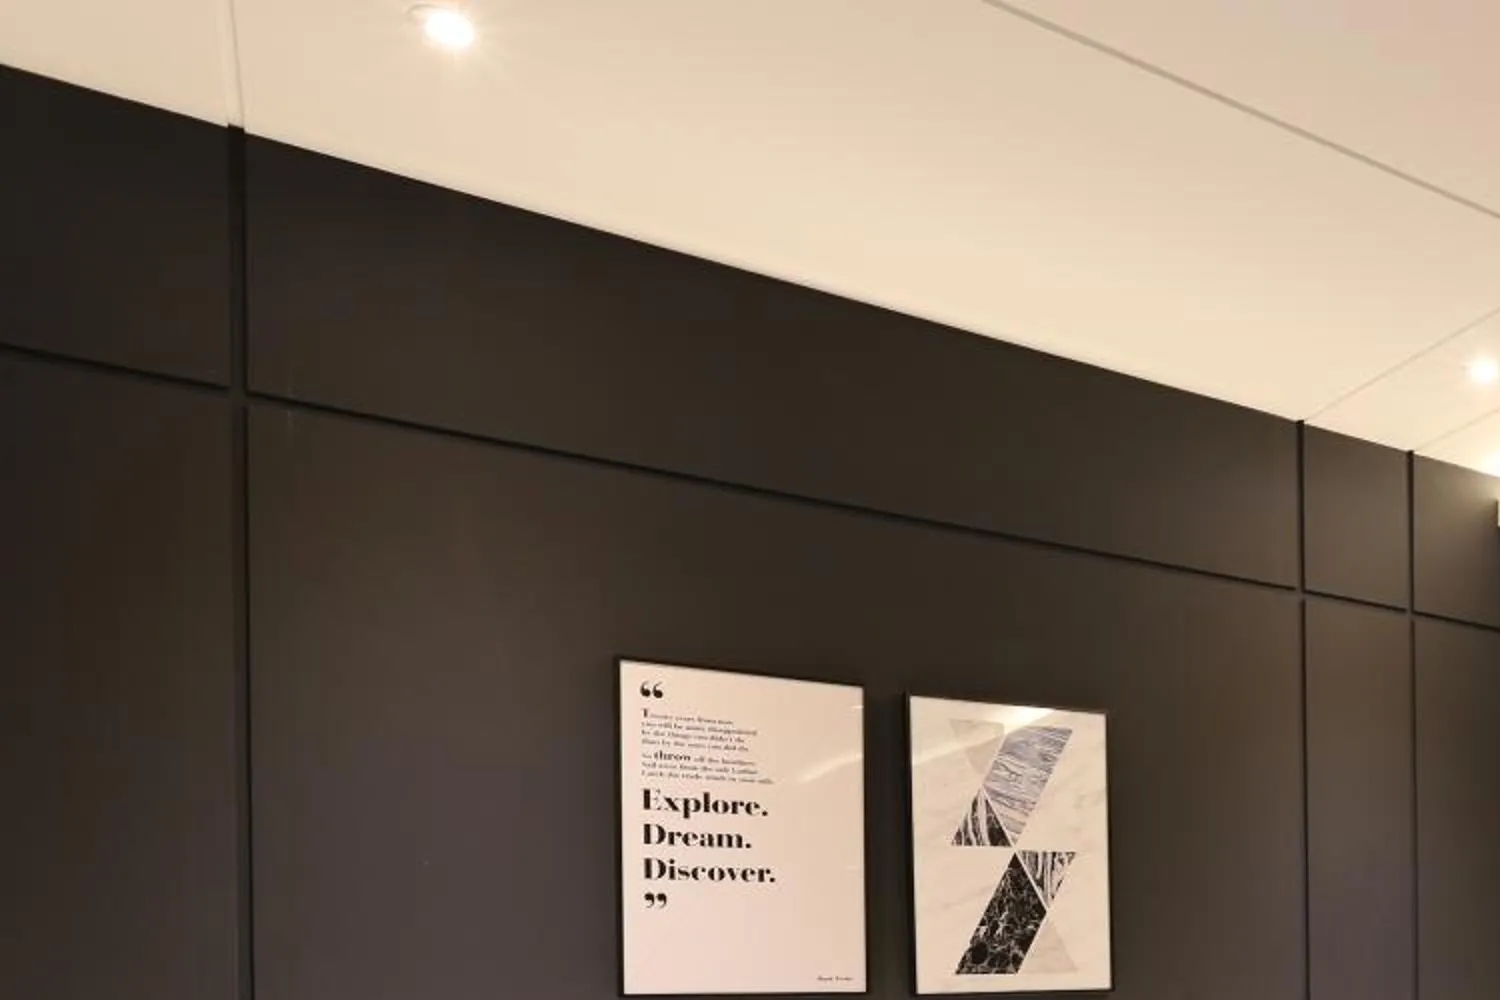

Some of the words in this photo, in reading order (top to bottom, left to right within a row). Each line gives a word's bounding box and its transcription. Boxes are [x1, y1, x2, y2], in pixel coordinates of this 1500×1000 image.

[642, 788, 769, 819] Explore.
[642, 823, 752, 849] Dream.
[643, 857, 776, 884] Discover.
